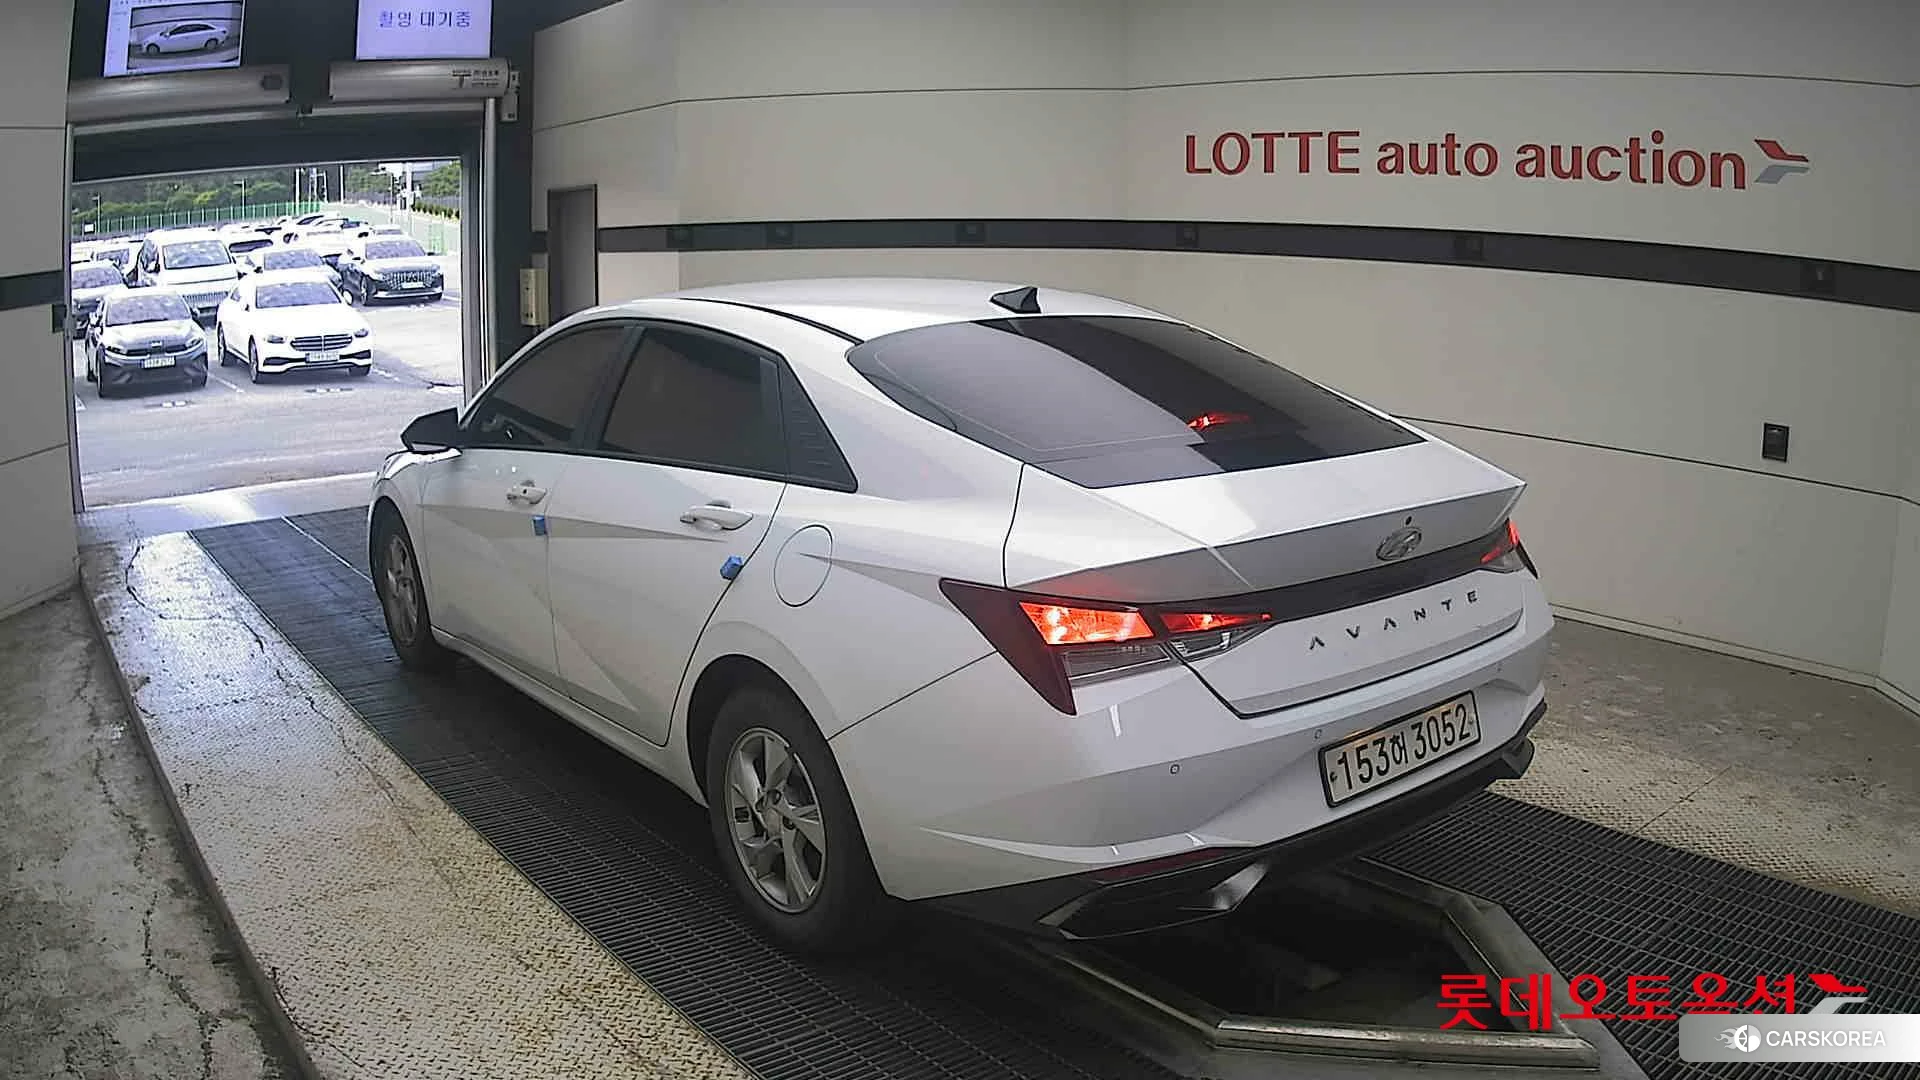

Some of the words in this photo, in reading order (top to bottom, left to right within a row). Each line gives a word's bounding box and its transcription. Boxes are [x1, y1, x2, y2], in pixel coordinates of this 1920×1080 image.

[420, 11, 471, 28] 대기중
[1185, 131, 1360, 175] LOTTE
[1376, 132, 1499, 178] auto
[1515, 130, 1747, 190] auction
[1308, 589, 1479, 651] AVANTE
[1410, 703, 1471, 760] 3052
